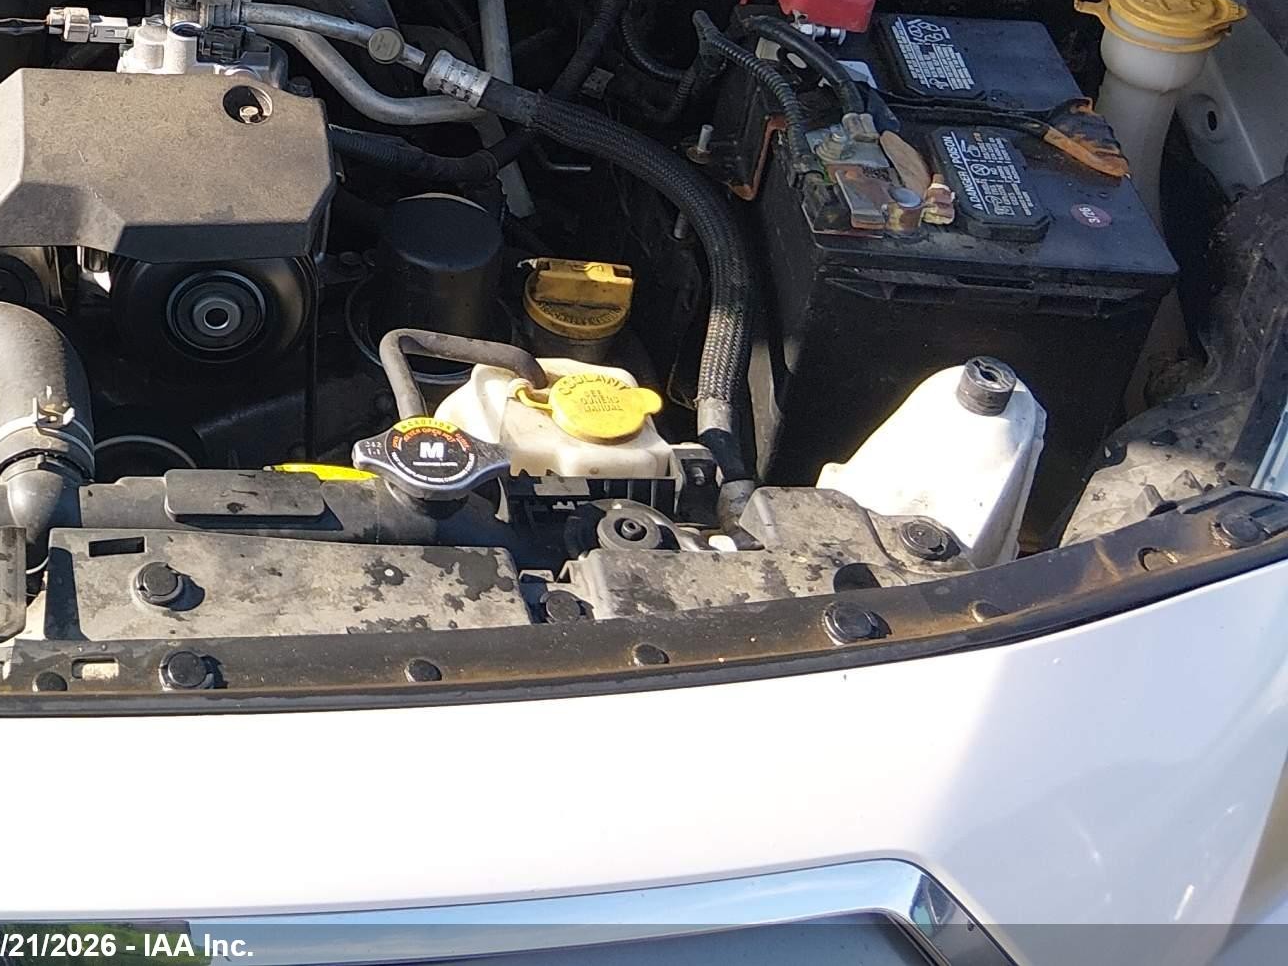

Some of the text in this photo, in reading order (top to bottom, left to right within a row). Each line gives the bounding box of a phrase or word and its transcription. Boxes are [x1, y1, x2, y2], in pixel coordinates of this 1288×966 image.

[941, 135, 963, 164] POISON
[957, 170, 981, 203] DANGER
[419, 442, 445, 459] M
